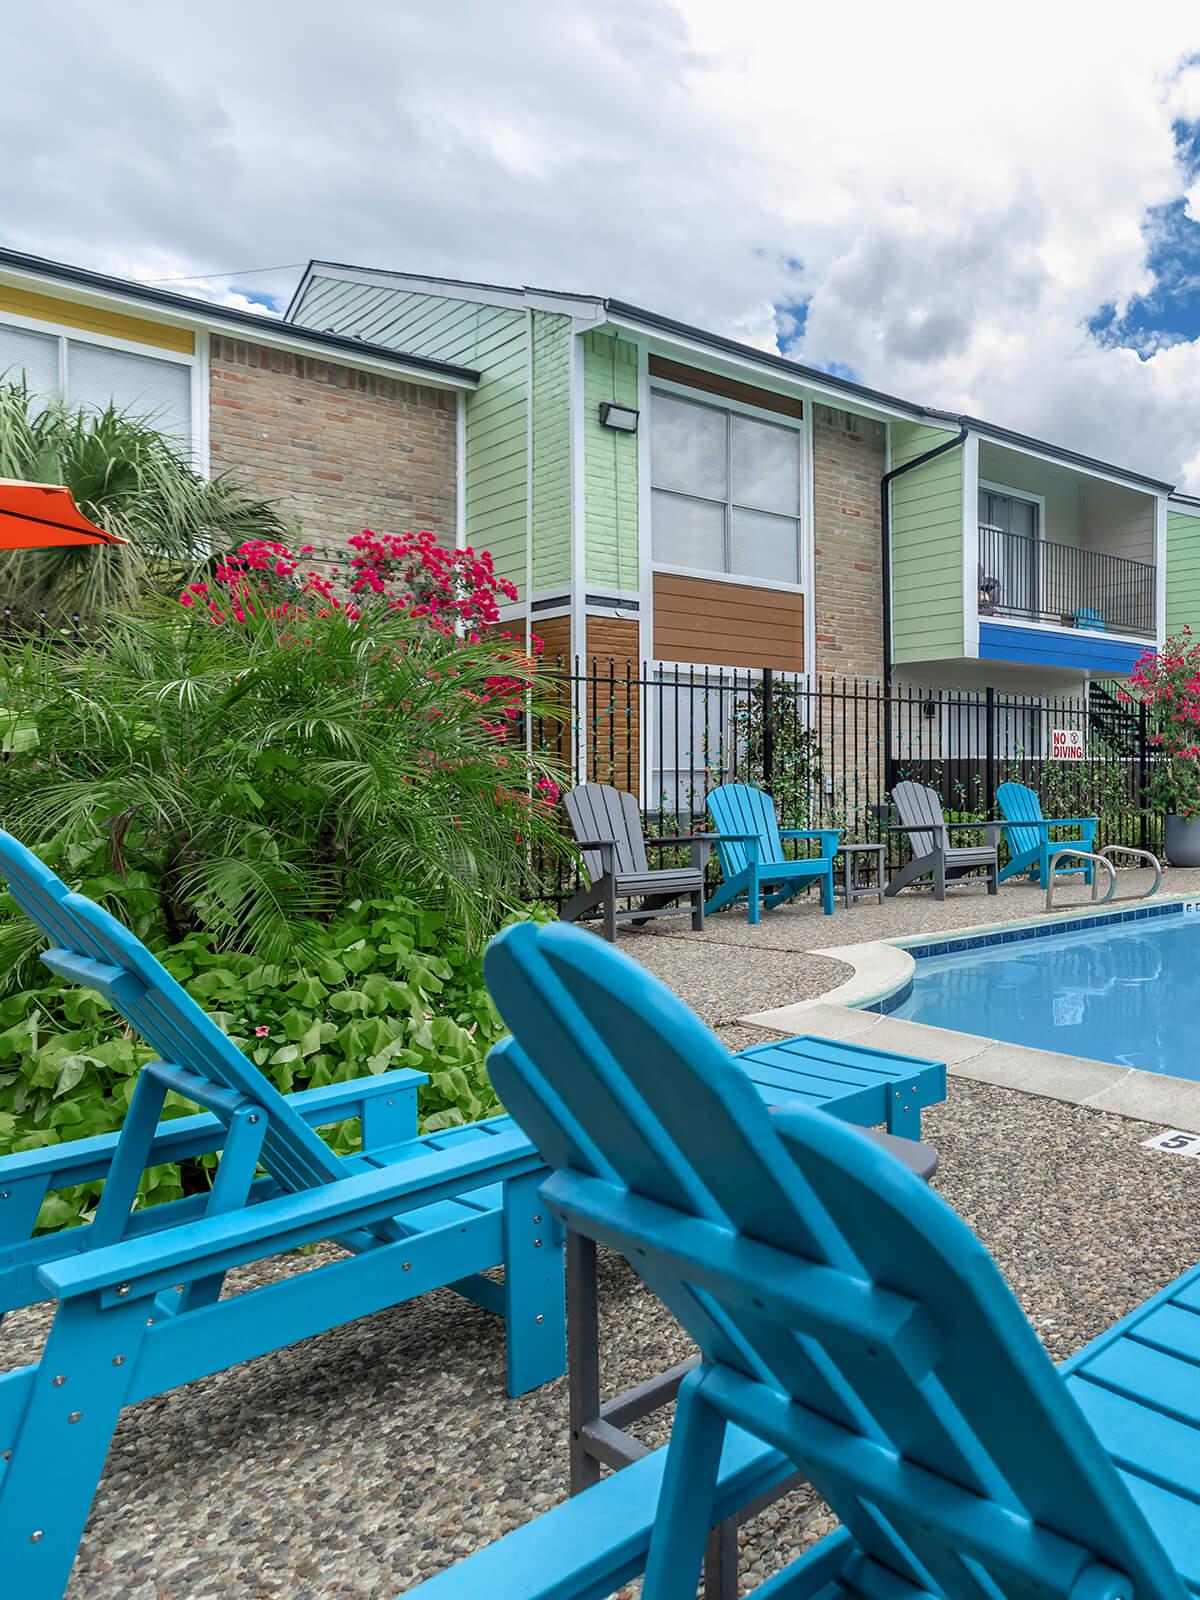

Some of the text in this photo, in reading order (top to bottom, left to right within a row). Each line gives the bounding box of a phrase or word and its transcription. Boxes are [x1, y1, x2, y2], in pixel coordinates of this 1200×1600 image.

[1053, 732, 1066, 745] NO
[1053, 746, 1082, 758] DIVING
[1159, 1135, 1196, 1149] 5
